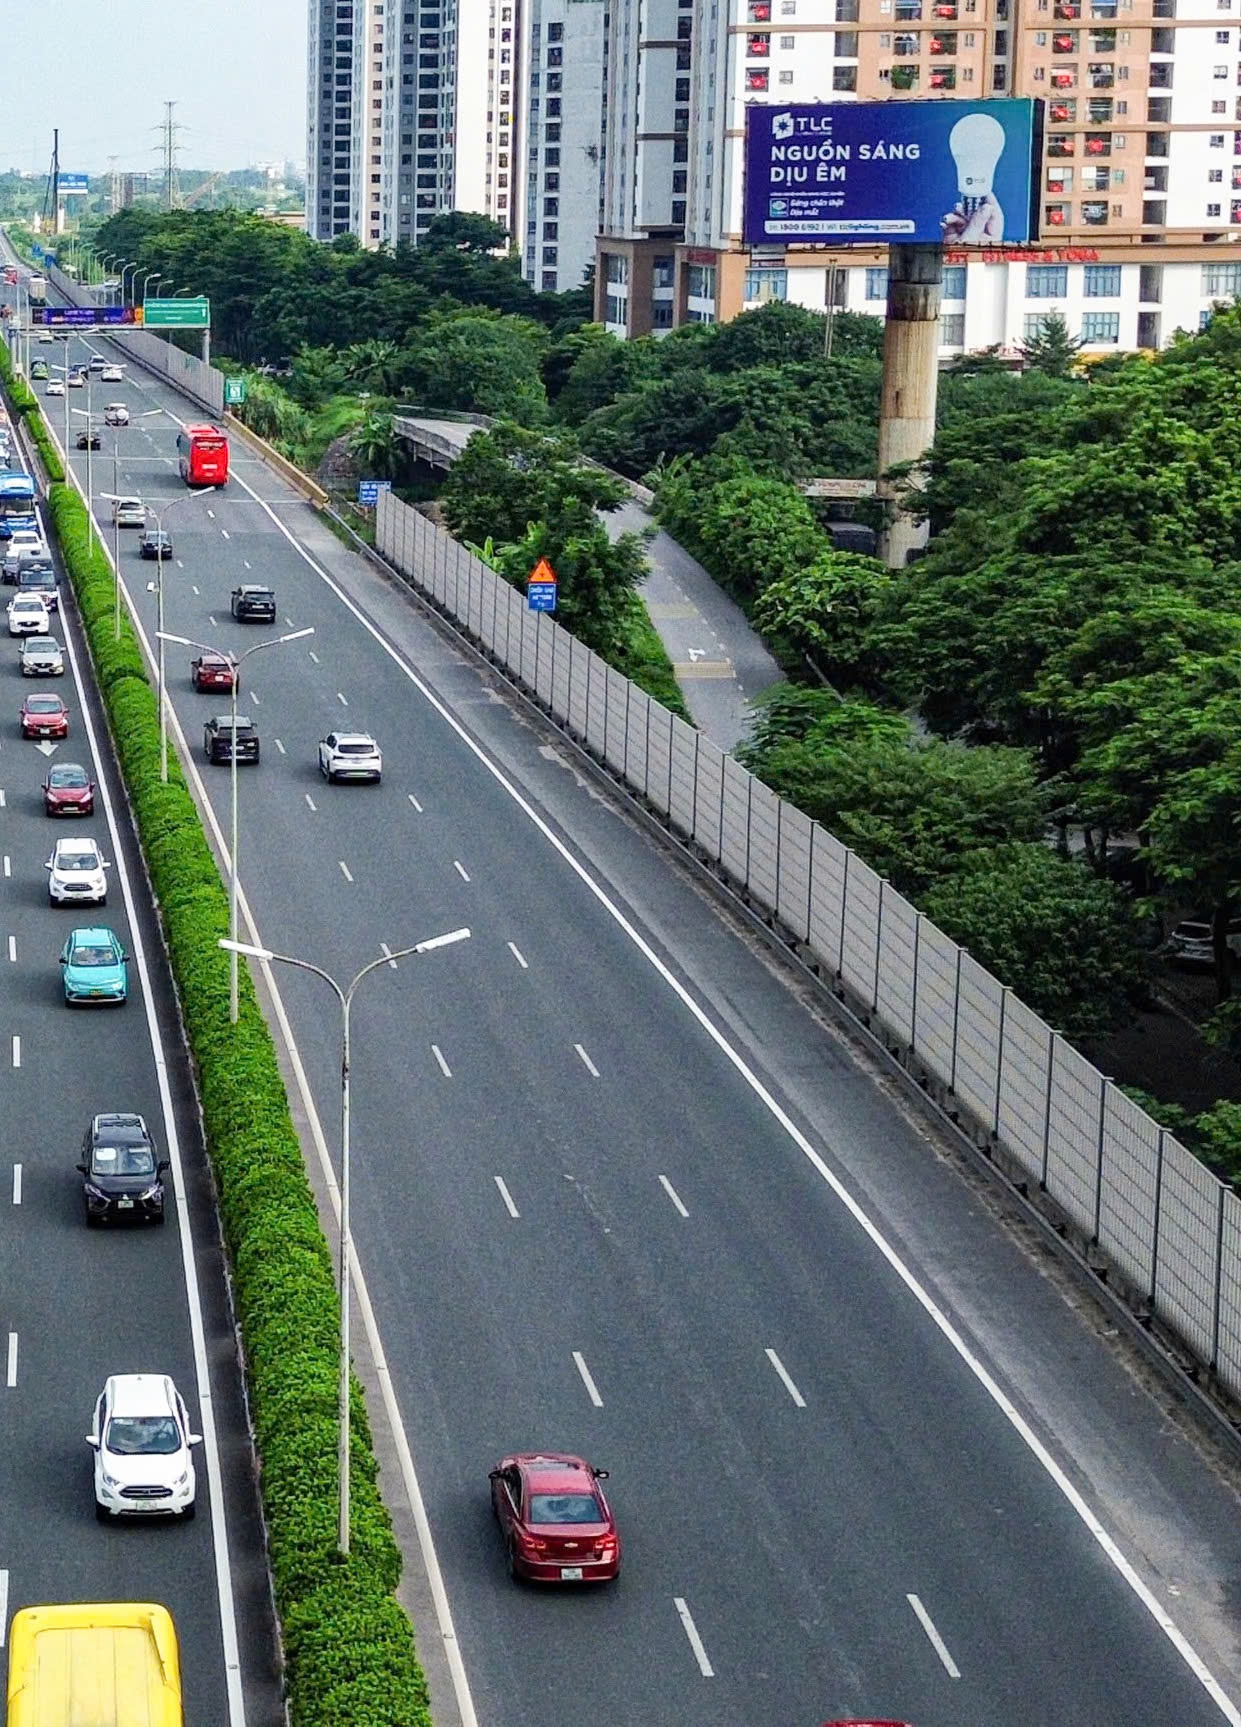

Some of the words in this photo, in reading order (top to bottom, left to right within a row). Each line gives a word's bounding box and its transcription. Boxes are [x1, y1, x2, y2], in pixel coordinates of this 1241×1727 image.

[796, 117, 833, 131] TLC
[771, 139, 851, 161] NGUỒN
[859, 140, 920, 160] SÁNG
[770, 166, 808, 186] DỊU
[816, 162, 846, 181] ÊM
